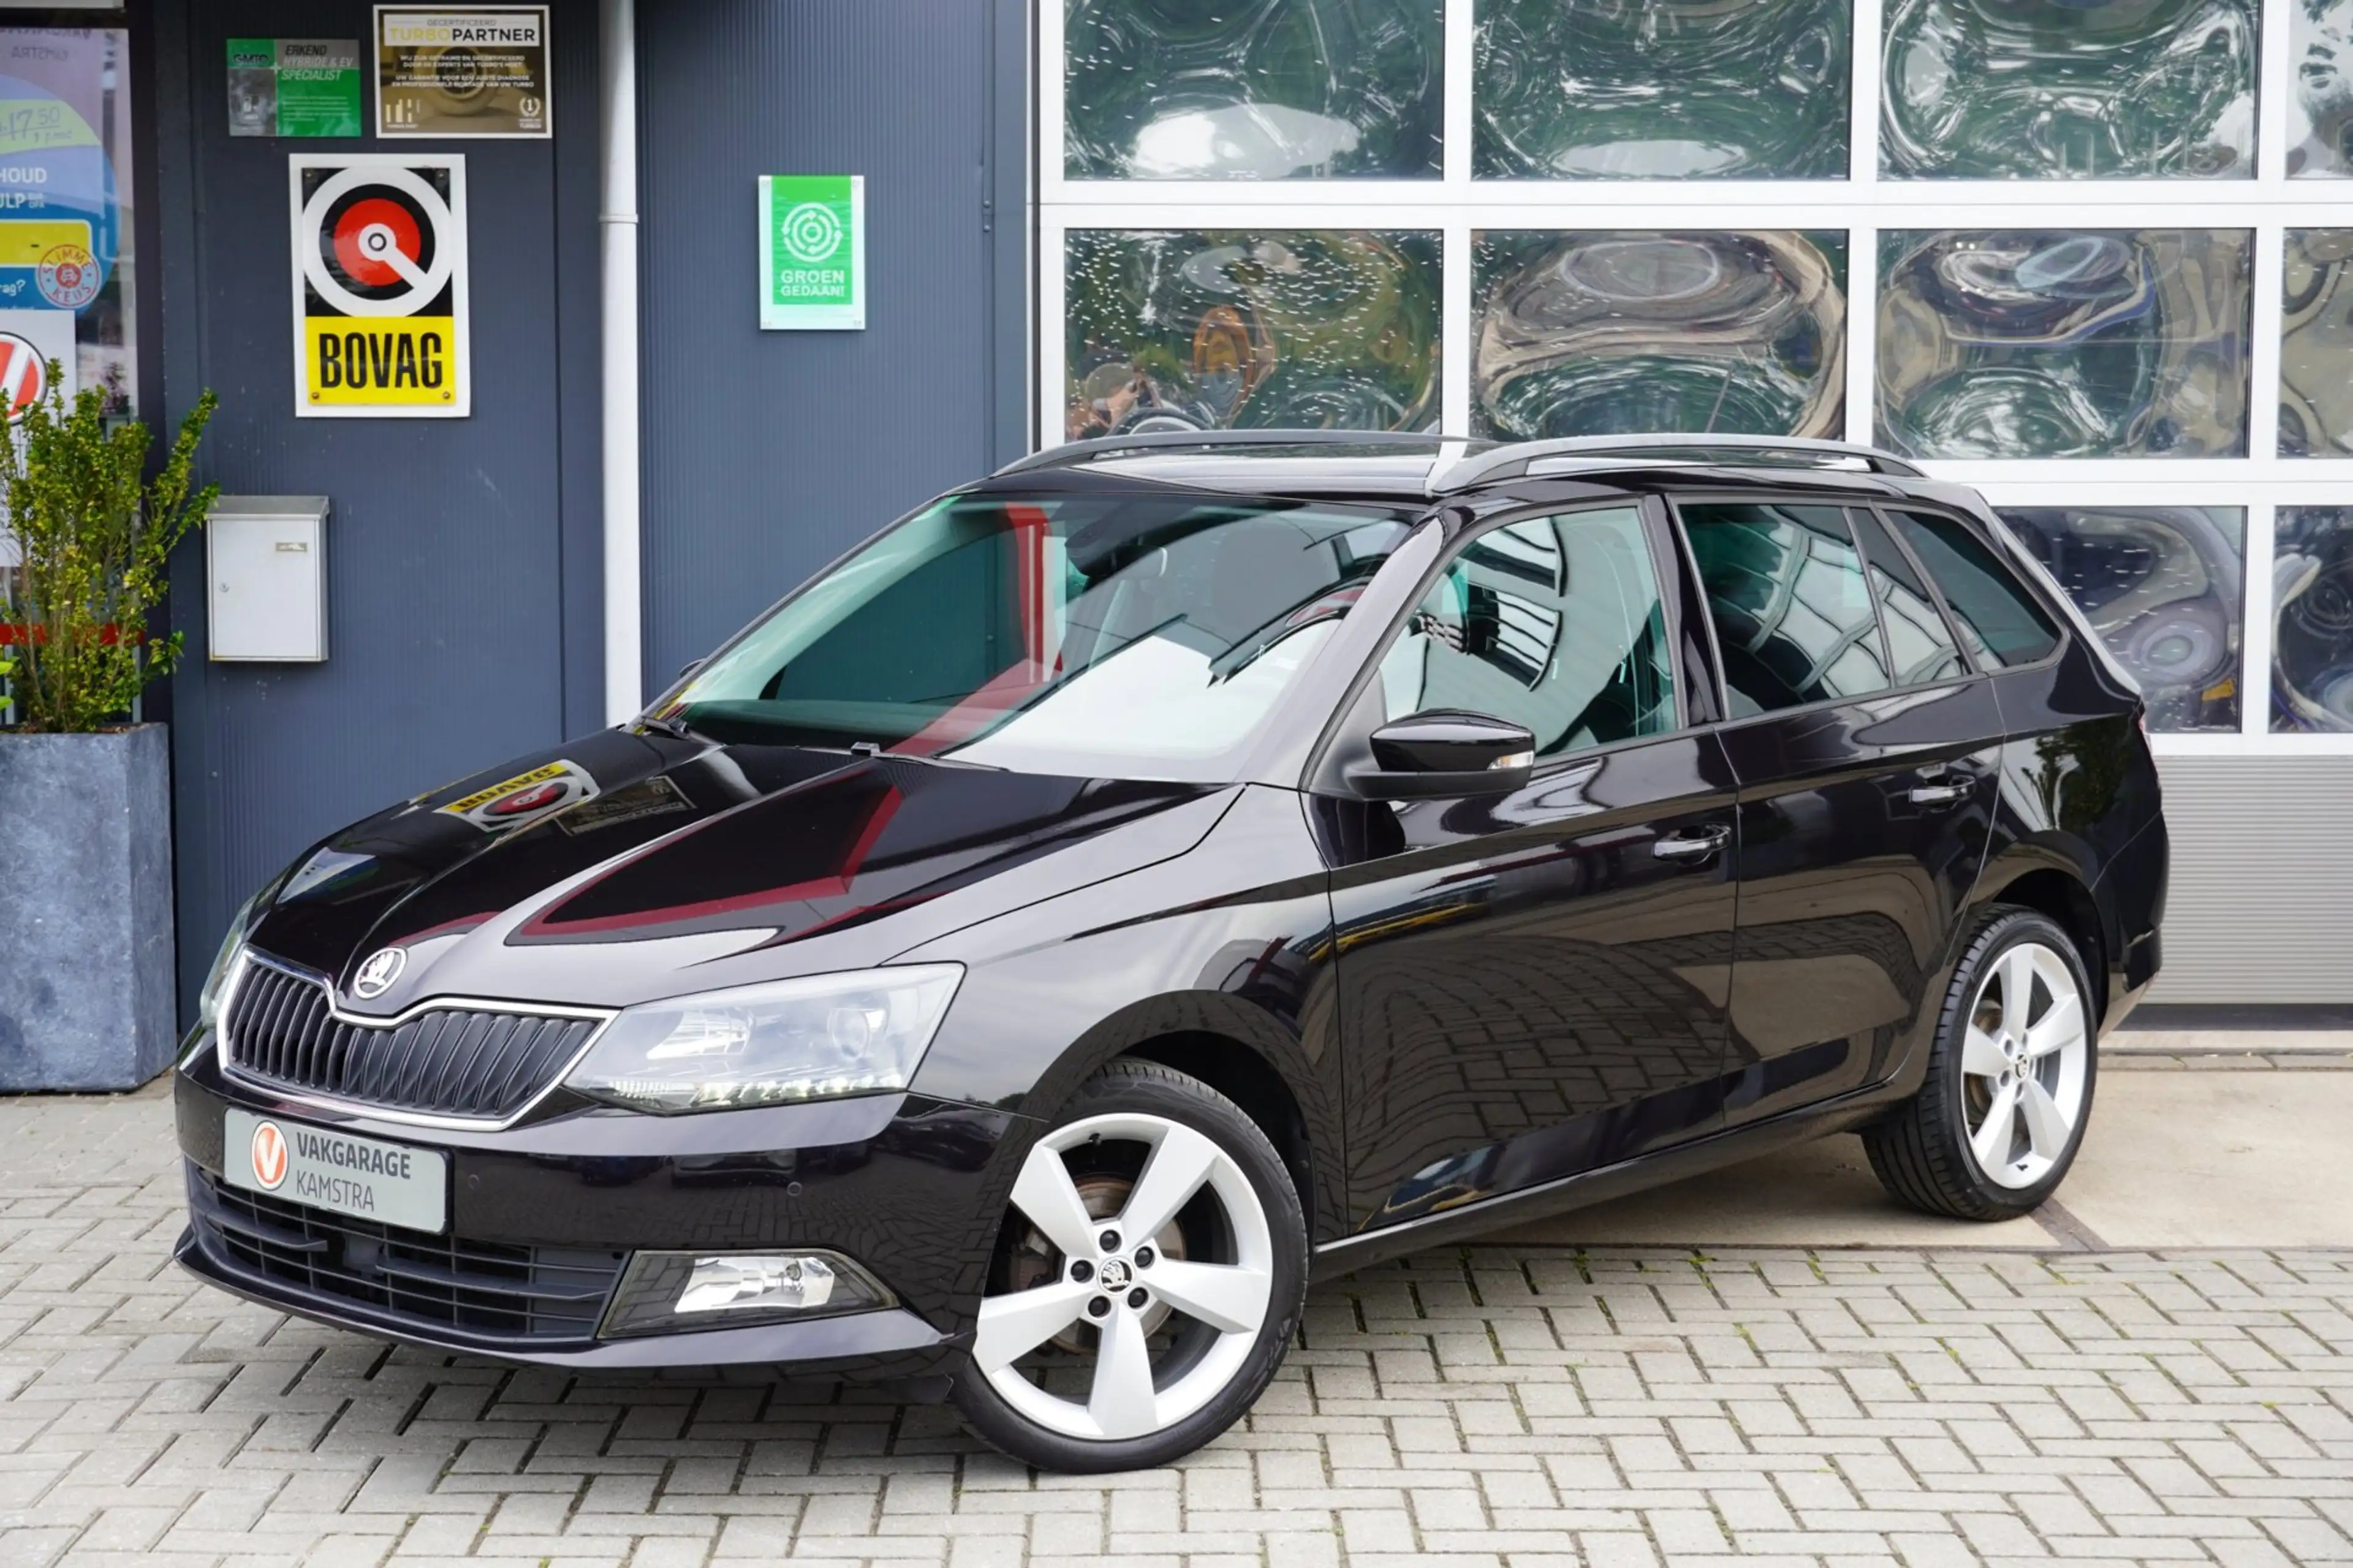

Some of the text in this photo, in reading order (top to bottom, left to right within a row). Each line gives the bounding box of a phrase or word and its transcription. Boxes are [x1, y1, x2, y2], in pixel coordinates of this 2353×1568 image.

[390, 28, 536, 42] TURBOPARTNER
[286, 45, 327, 56] ERKEND
[283, 57, 327, 67] HYBRIDE
[340, 57, 354, 67] EV
[281, 70, 343, 80] SPECIALIST
[781, 270, 844, 284] GROEN
[781, 285, 845, 297] GEDAAN!
[319, 332, 442, 389] BOVAG
[297, 1132, 411, 1180] VAKGARAGE
[297, 1170, 374, 1212] KAMSTRA
